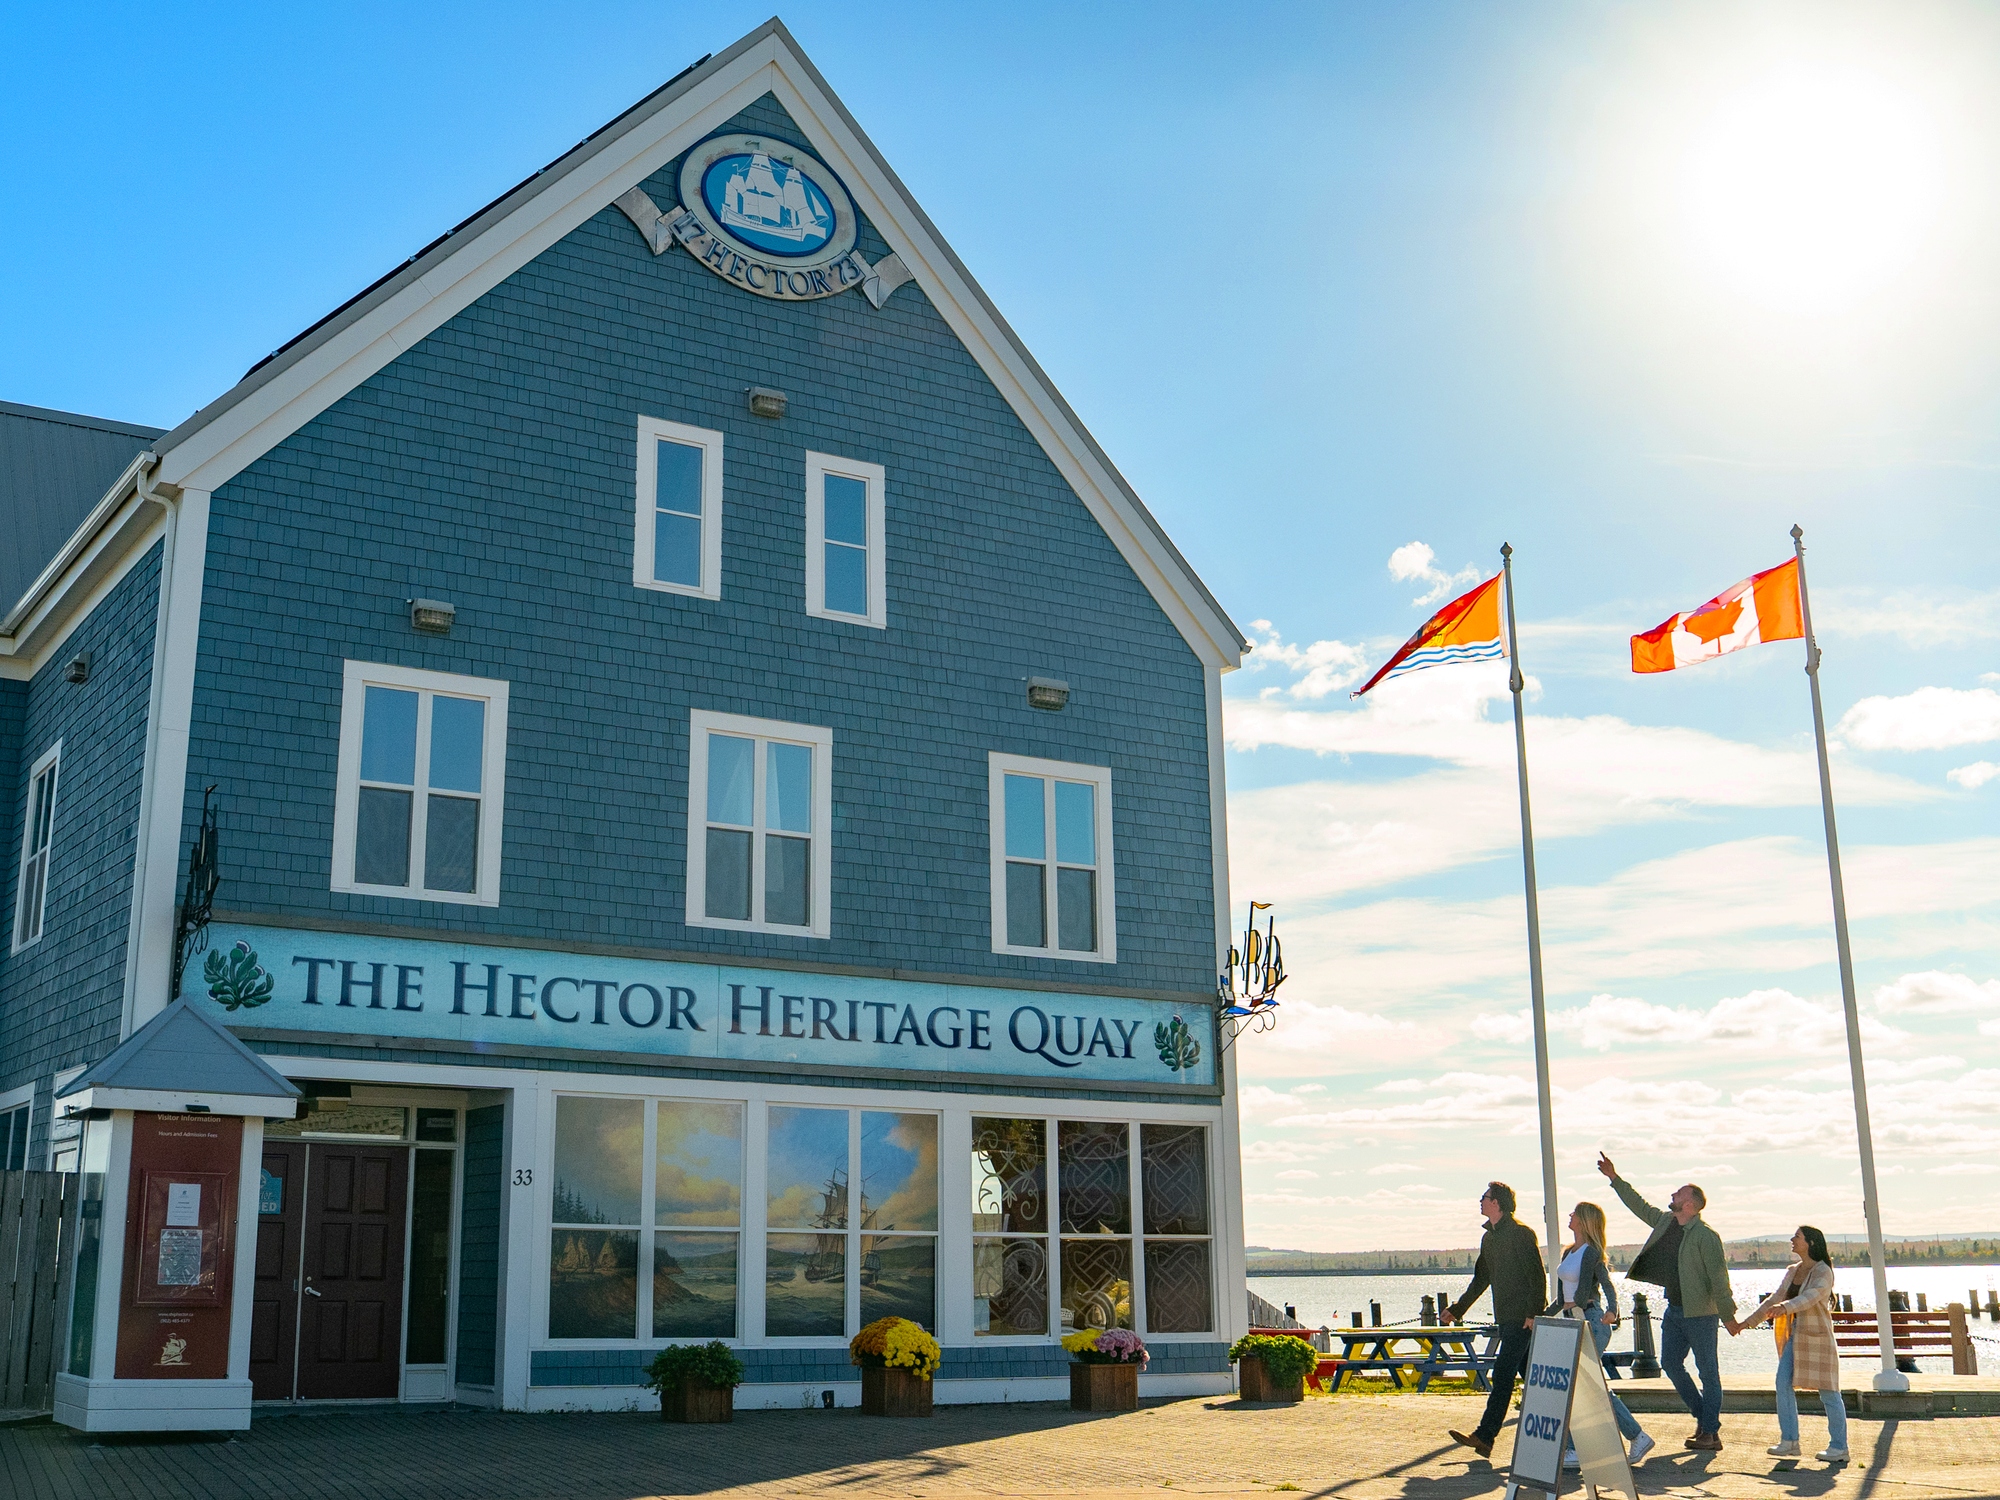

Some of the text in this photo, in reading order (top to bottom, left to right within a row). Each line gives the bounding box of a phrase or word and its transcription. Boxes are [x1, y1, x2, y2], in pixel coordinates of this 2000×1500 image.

[702, 239, 832, 296] HECTOR
[292, 955, 1143, 1068] THE HECTOR HERITAGE QUAY
[513, 1169, 532, 1186] 33
[1529, 1363, 1570, 1391] BUSES
[1525, 1413, 1561, 1442] ONLY
